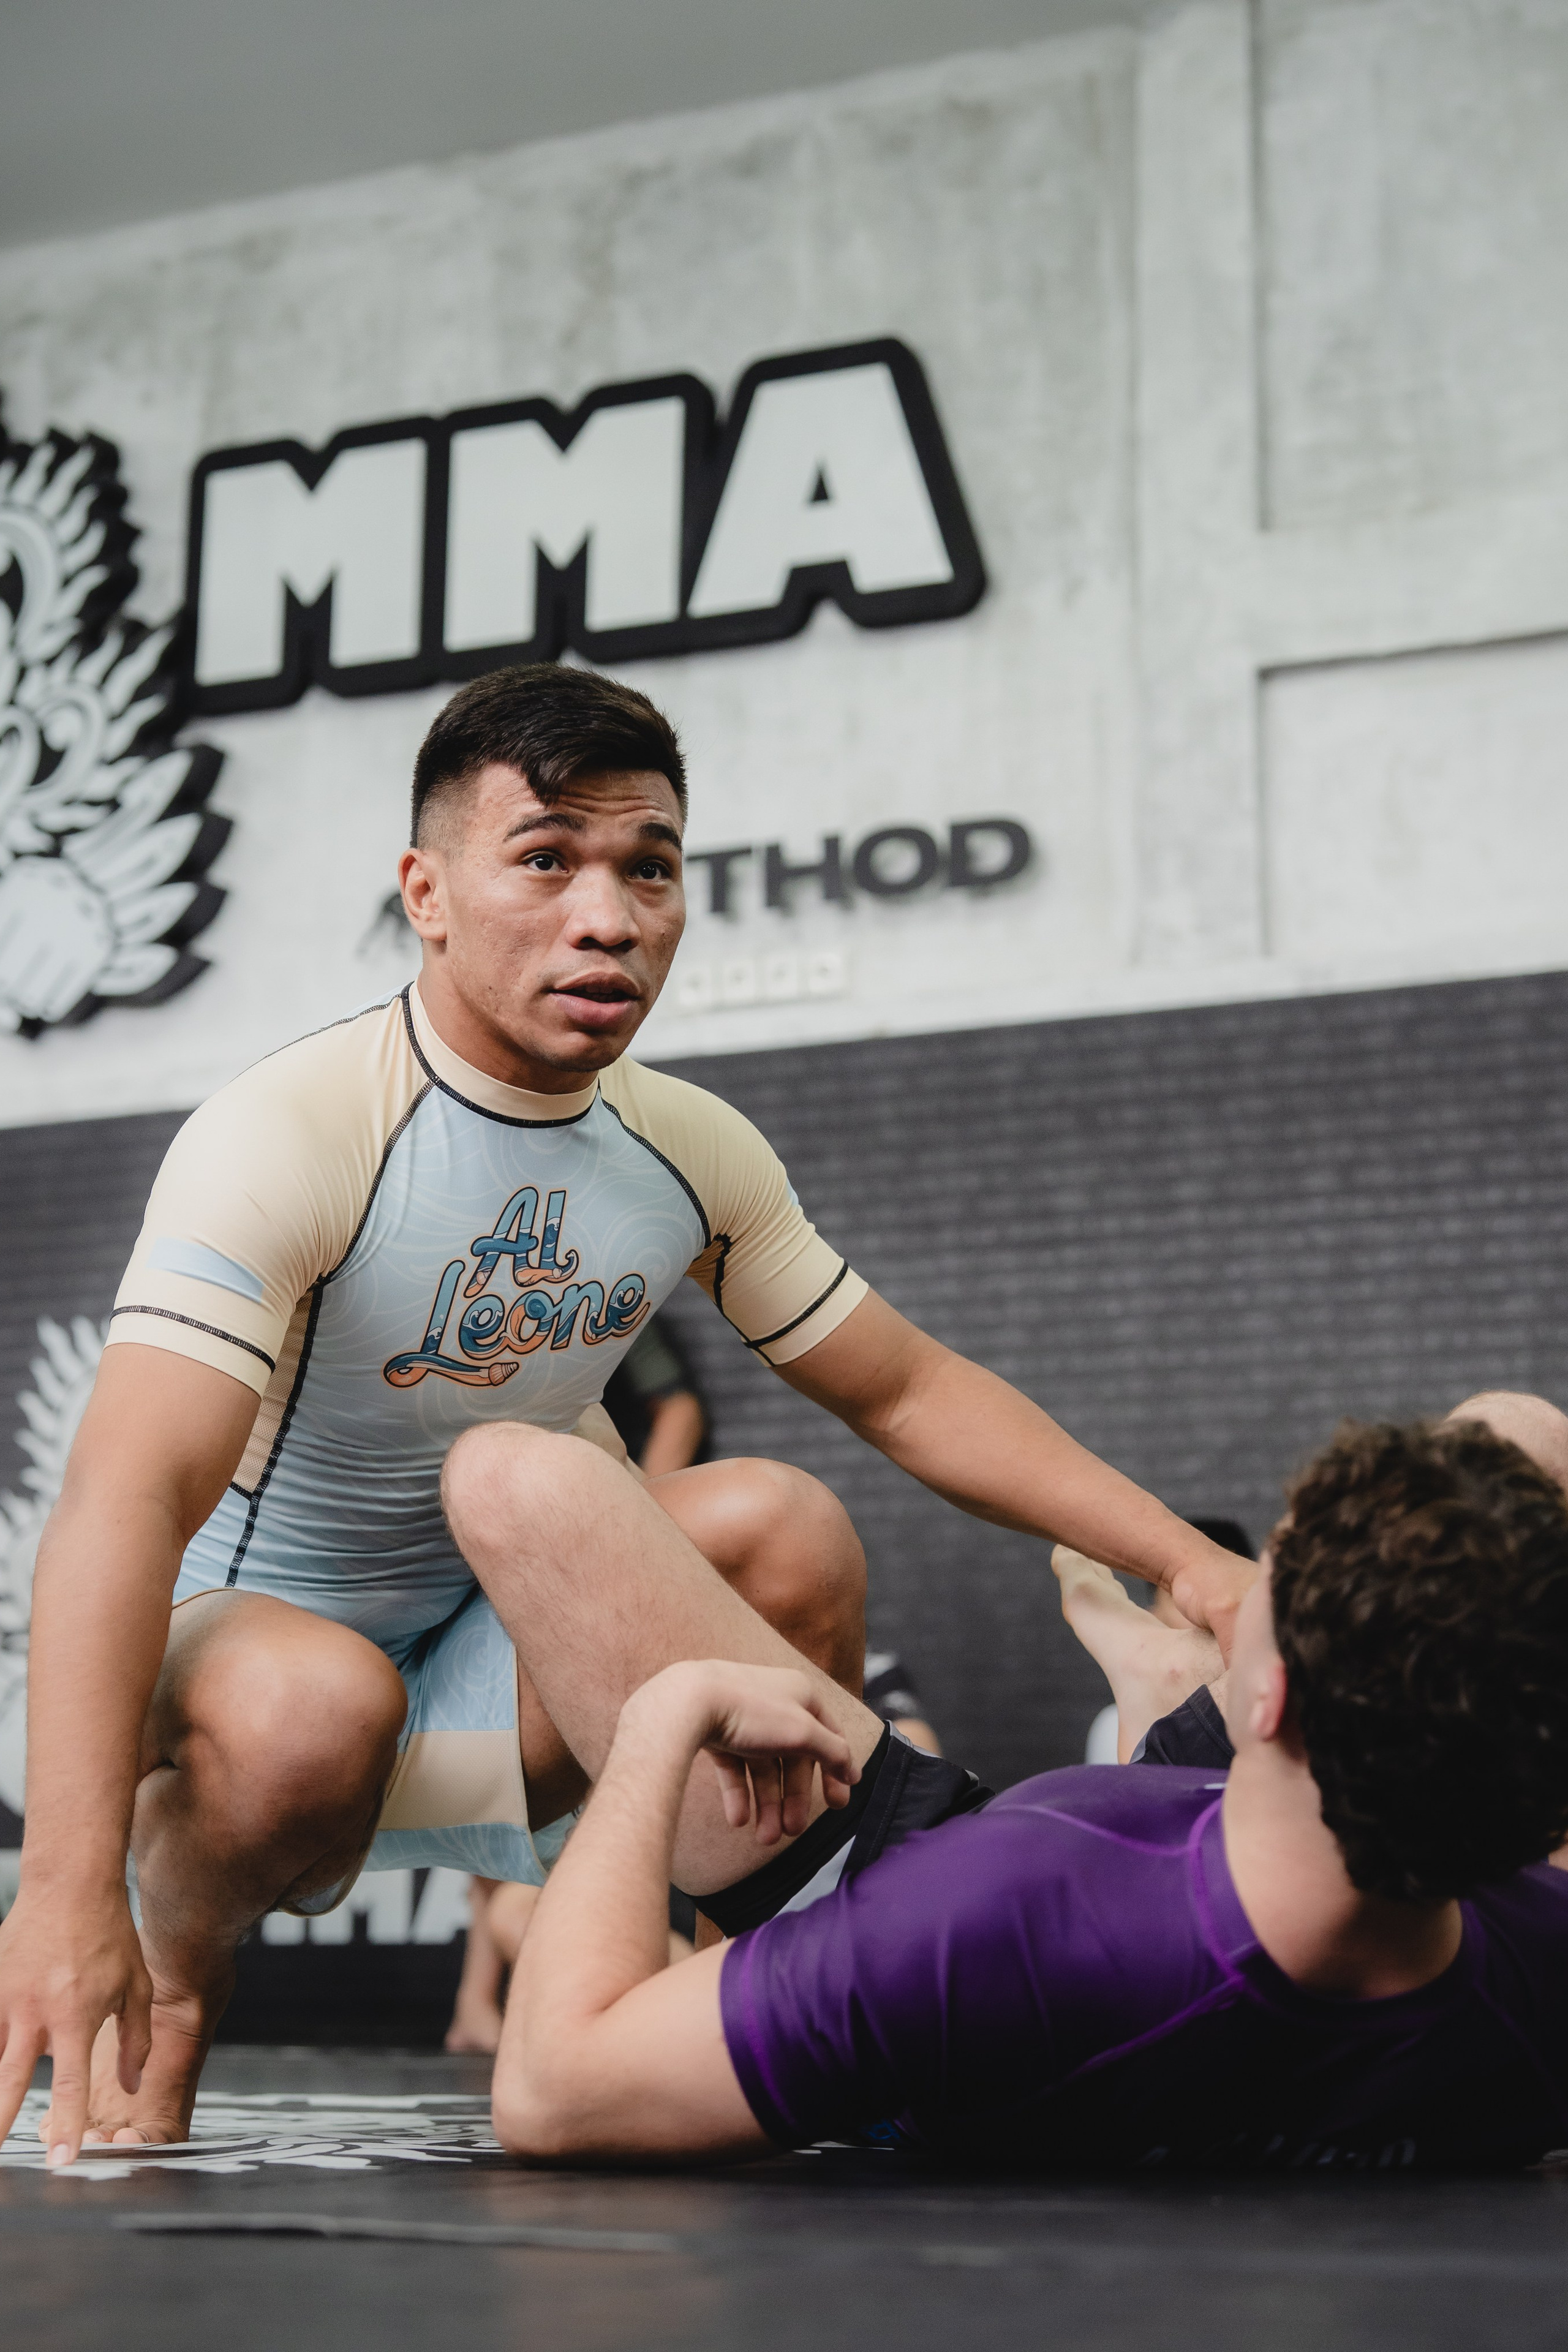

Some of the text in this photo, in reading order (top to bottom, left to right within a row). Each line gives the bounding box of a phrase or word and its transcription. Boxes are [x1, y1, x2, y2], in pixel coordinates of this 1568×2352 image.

[192, 358, 959, 688] MMA
[685, 817, 1033, 915] THOD
[464, 1186, 579, 1298] Al
[383, 1259, 650, 1388] Leone
